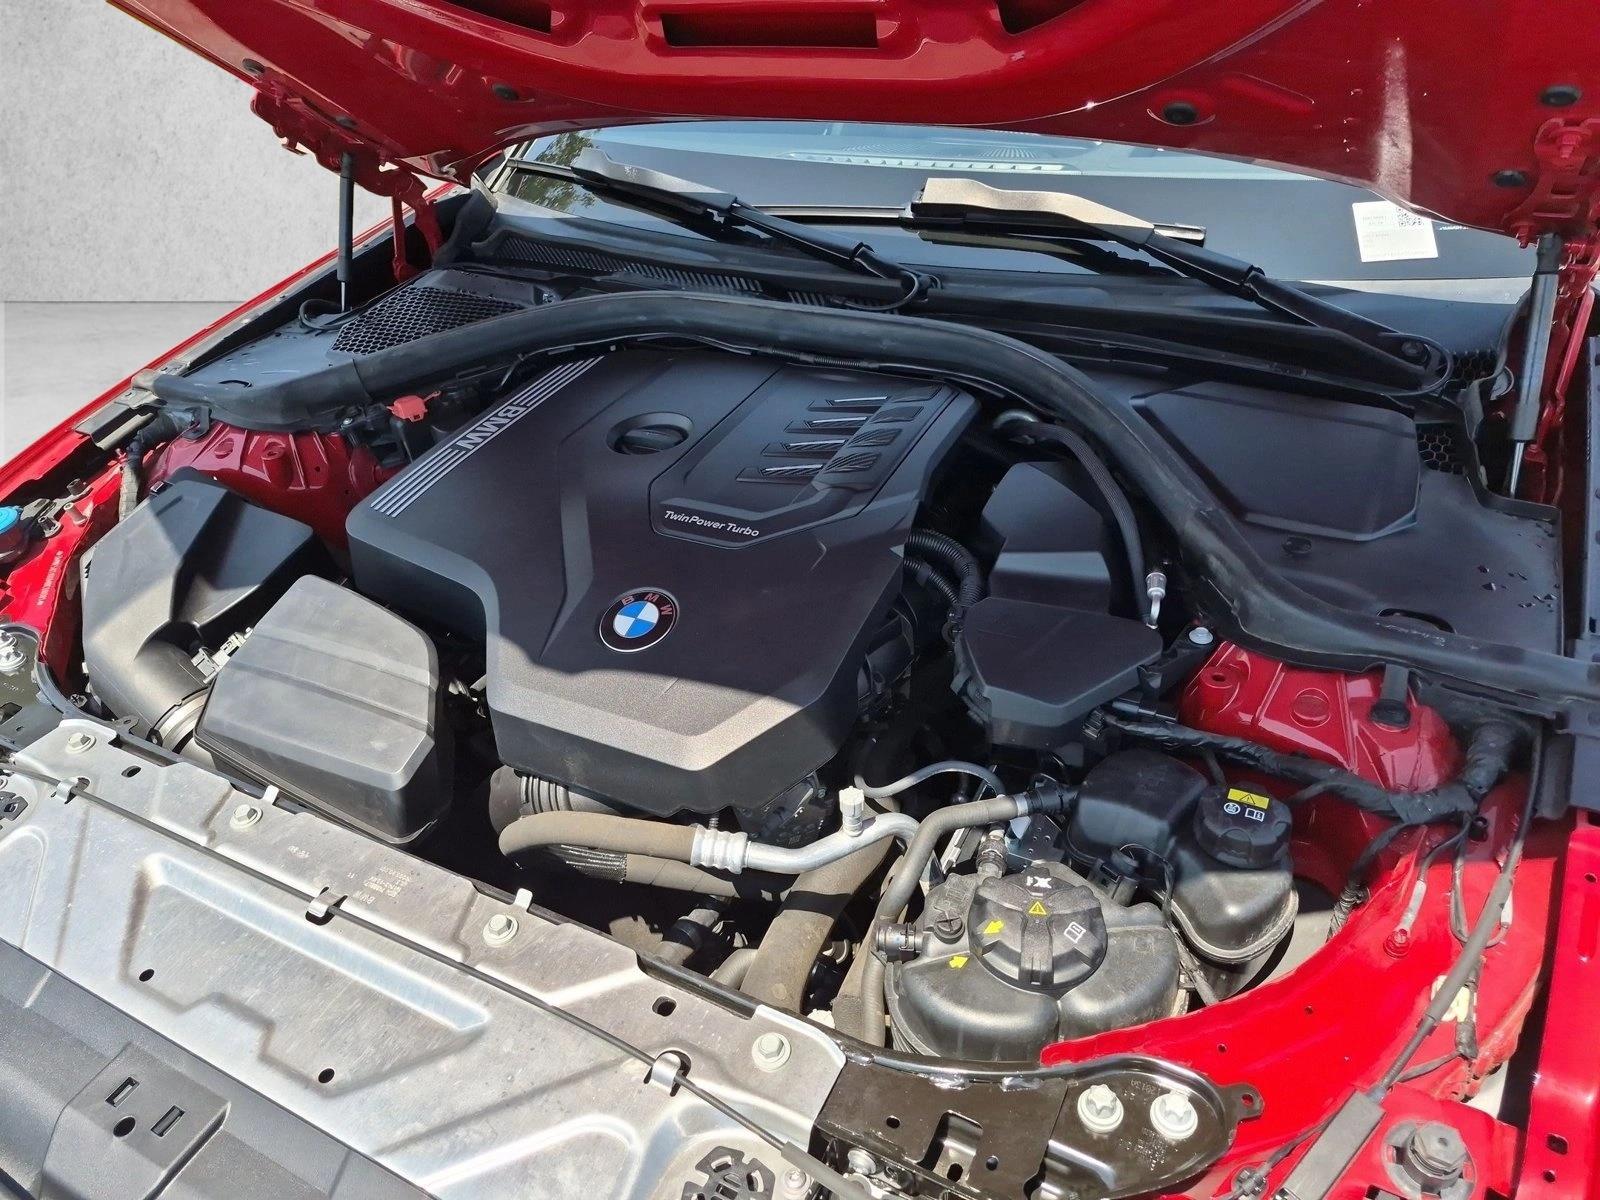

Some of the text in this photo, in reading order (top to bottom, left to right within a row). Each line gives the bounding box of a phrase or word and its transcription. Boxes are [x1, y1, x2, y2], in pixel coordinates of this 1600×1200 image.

[456, 405, 527, 450] BMW
[664, 510, 760, 537] TwinPower Turbo
[621, 592, 673, 615] BMW
